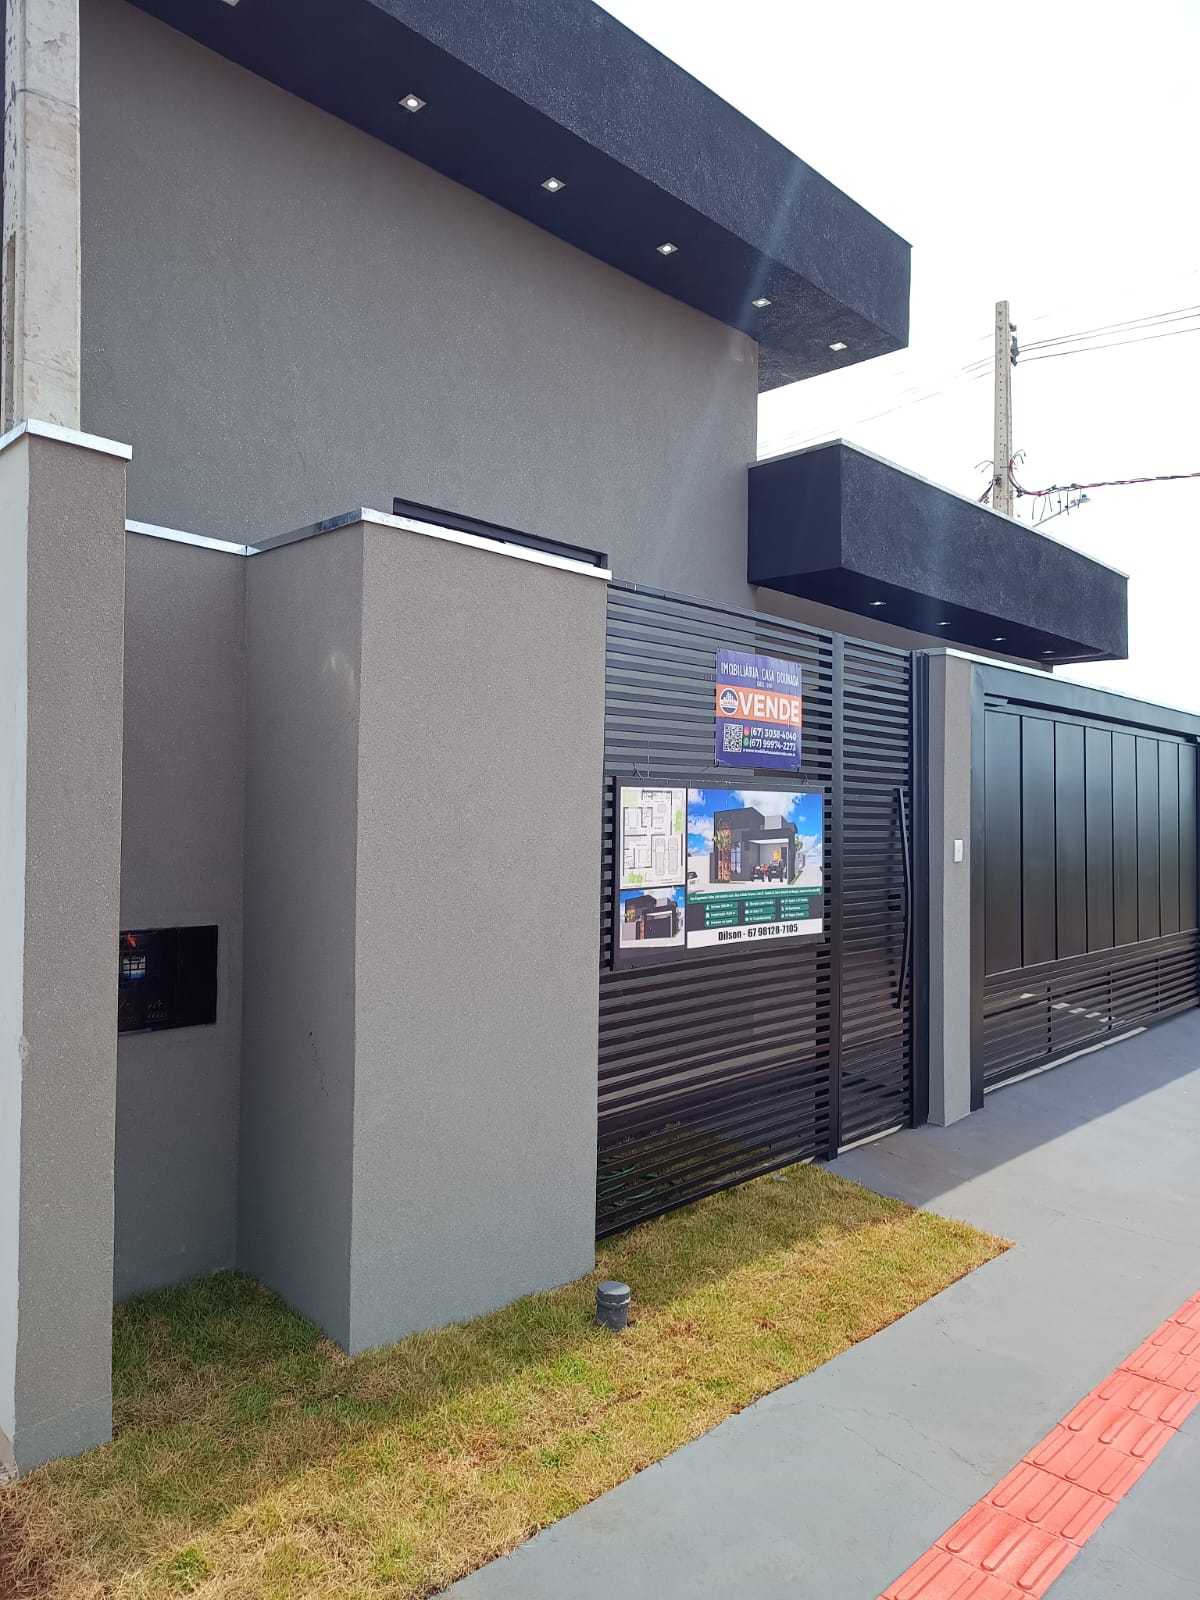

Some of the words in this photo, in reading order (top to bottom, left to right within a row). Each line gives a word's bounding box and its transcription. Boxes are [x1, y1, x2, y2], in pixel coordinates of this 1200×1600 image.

[739, 692, 800, 723] VENDE
[750, 726, 764, 738] (67)
[749, 738, 762, 749] (67)
[718, 930, 742, 941] Dilson
[747, 927, 757, 938] 67
